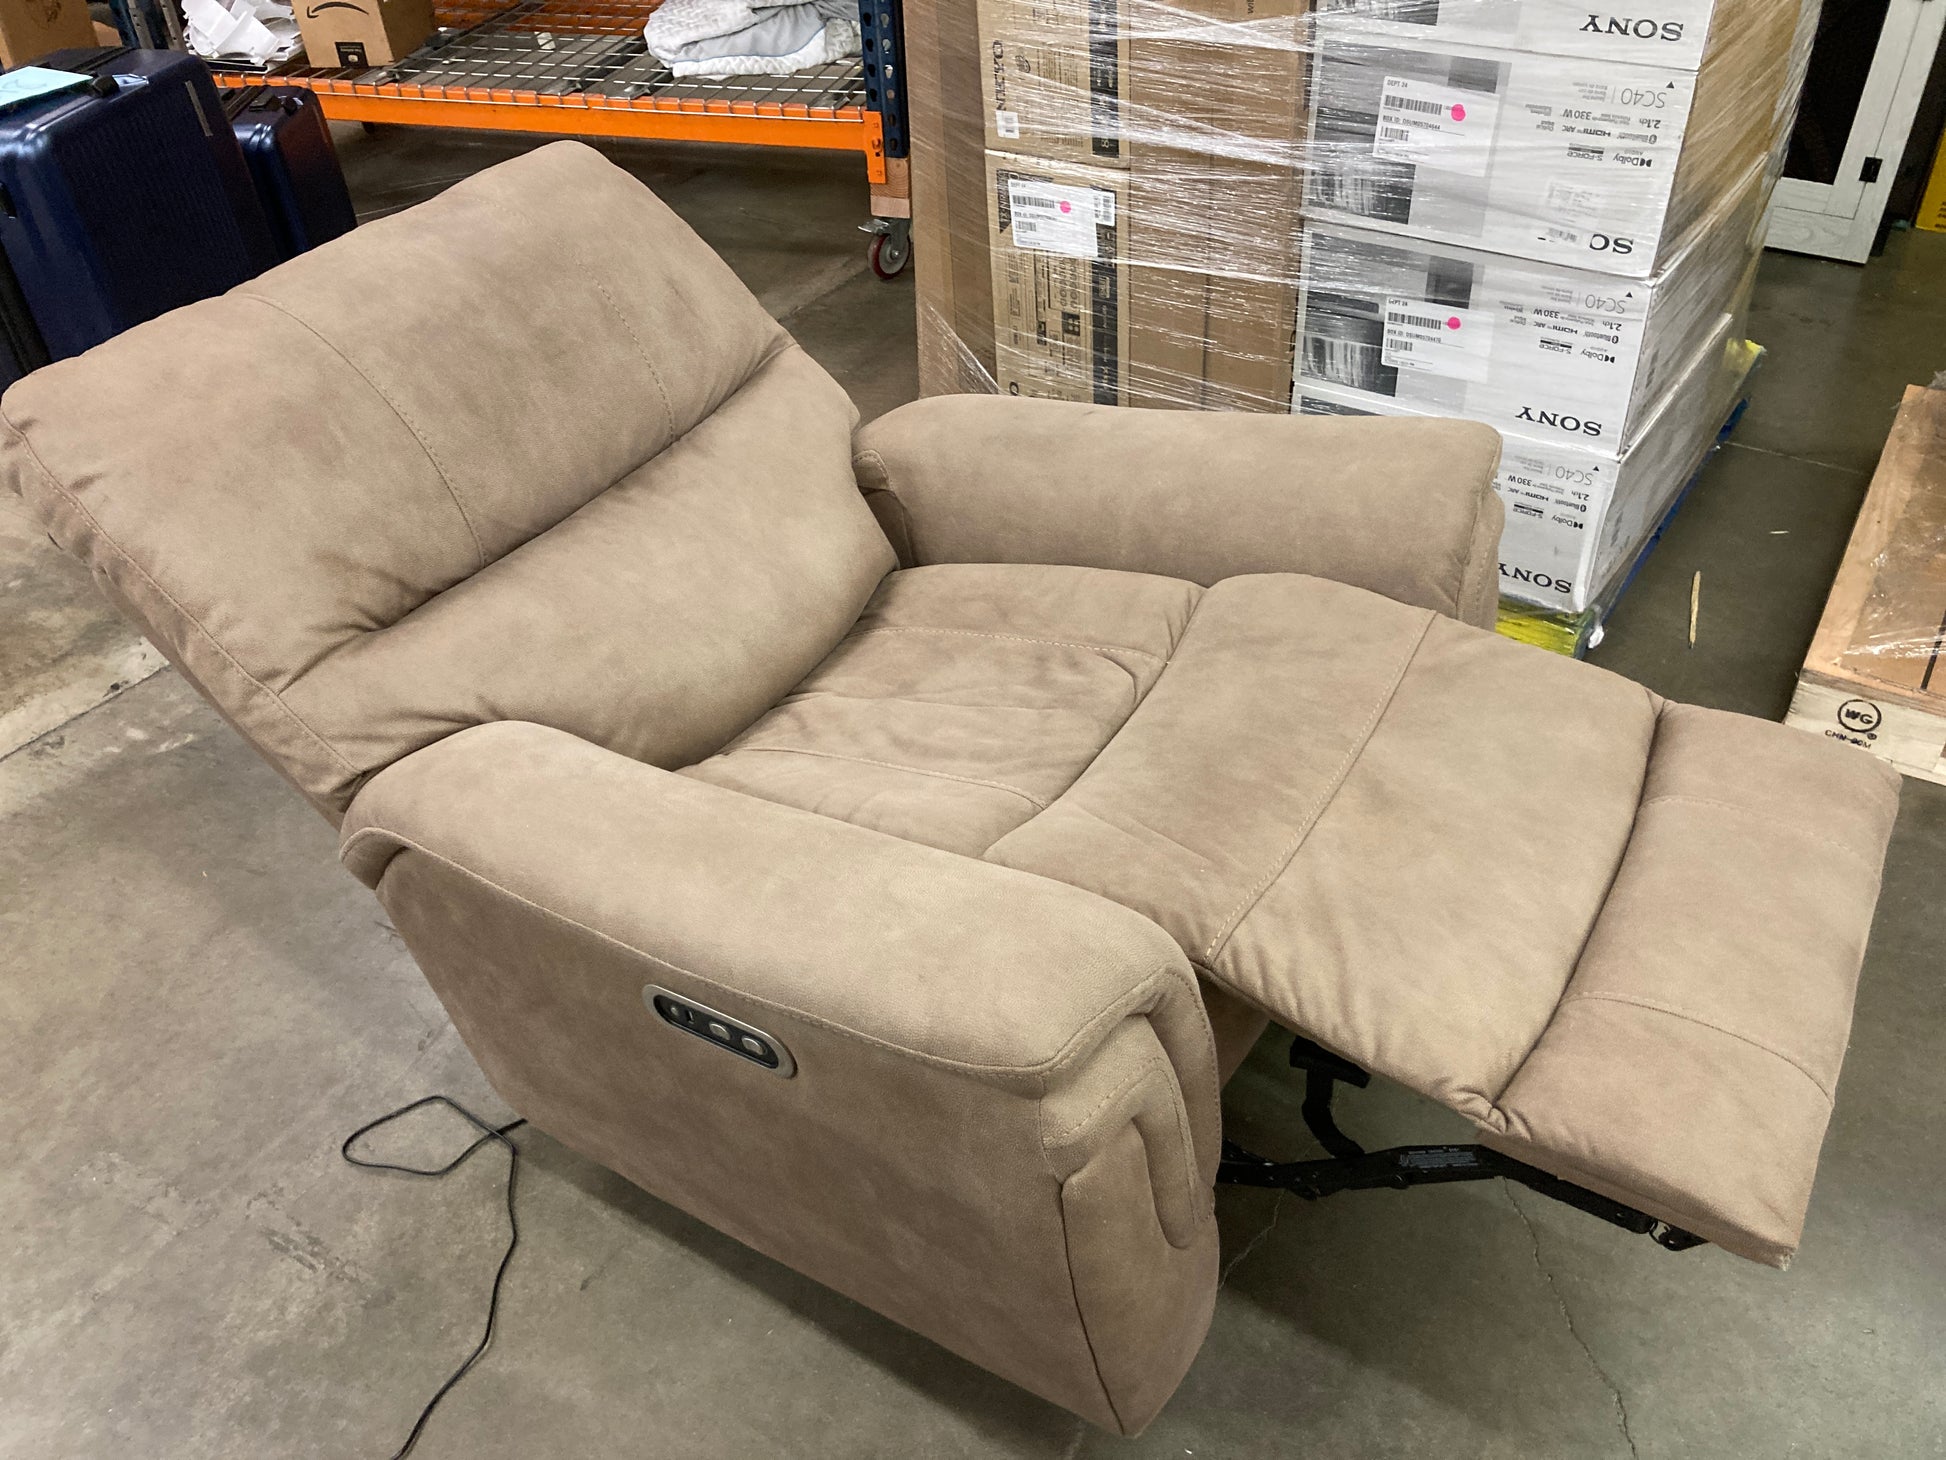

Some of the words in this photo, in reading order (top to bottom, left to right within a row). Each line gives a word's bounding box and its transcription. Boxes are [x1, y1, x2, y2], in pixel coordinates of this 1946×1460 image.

[1579, 14, 1684, 41] SONY
[1621, 88, 1667, 108] SC40
[1639, 118, 1661, 129] 2.1ch
[1584, 128, 1611, 138] HDMI
[1613, 153, 1639, 167] Dolby
[1585, 294, 1626, 314] SC40
[1553, 325, 1578, 334] HDMI
[1603, 320, 1622, 331] 2.1ch
[1581, 349, 1604, 361] Dolby
[1515, 406, 1602, 436] SONY
[1555, 466, 1594, 486] SC40
[1525, 491, 1549, 502] HDMI
[1571, 490, 1590, 501] 2.1ch
[1551, 515, 1573, 527] Dolby
[1498, 563, 1572, 593] SONY
[1845, 709, 1874, 725] WG
